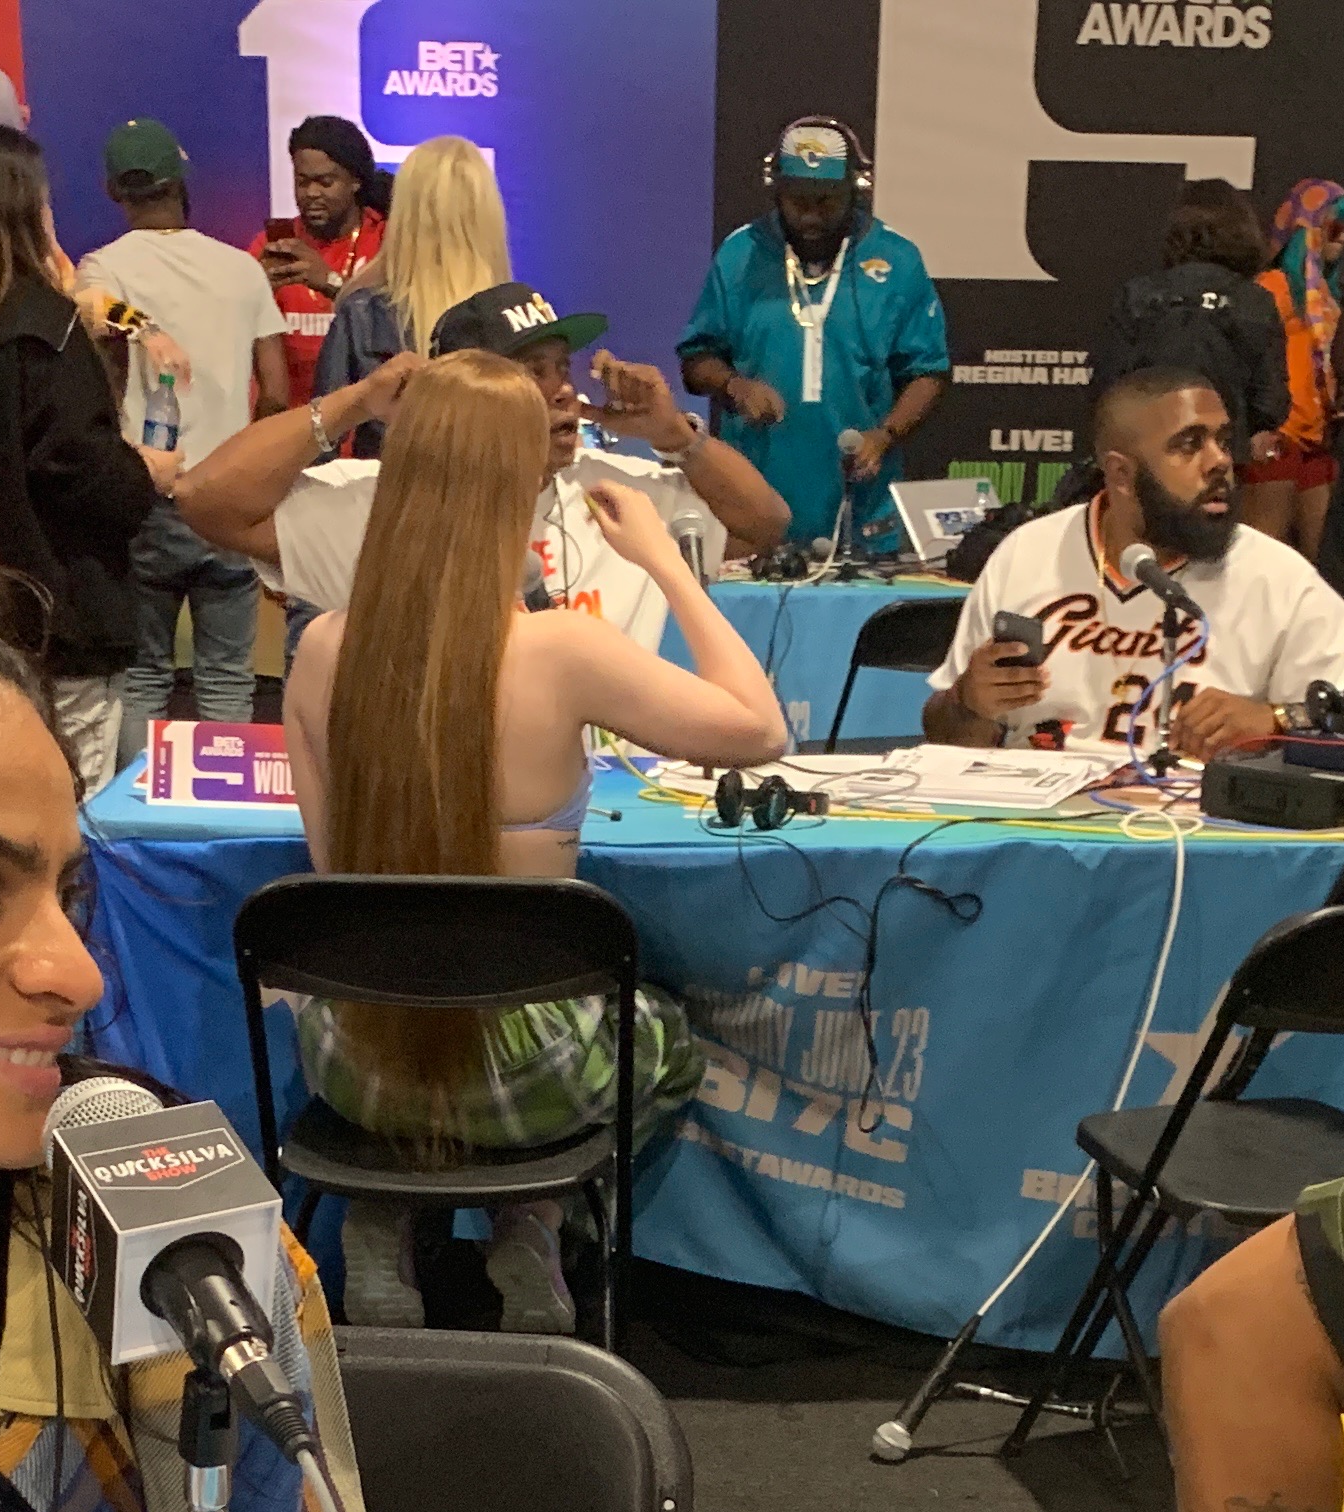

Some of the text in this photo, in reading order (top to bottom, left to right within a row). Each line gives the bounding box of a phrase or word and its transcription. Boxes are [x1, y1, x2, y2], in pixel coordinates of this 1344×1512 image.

[1076, 3, 1273, 49] AWARDS
[418, 41, 485, 71] BET
[383, 71, 499, 97] AWARDS
[286, 312, 336, 336] PUM
[984, 350, 1089, 364] HOSTED BY
[953, 365, 1049, 385] REGINA
[990, 429, 1074, 452] LIVE!
[93, 1143, 234, 1184] QUICKSILVA
[144, 1164, 198, 1182] SHOW
